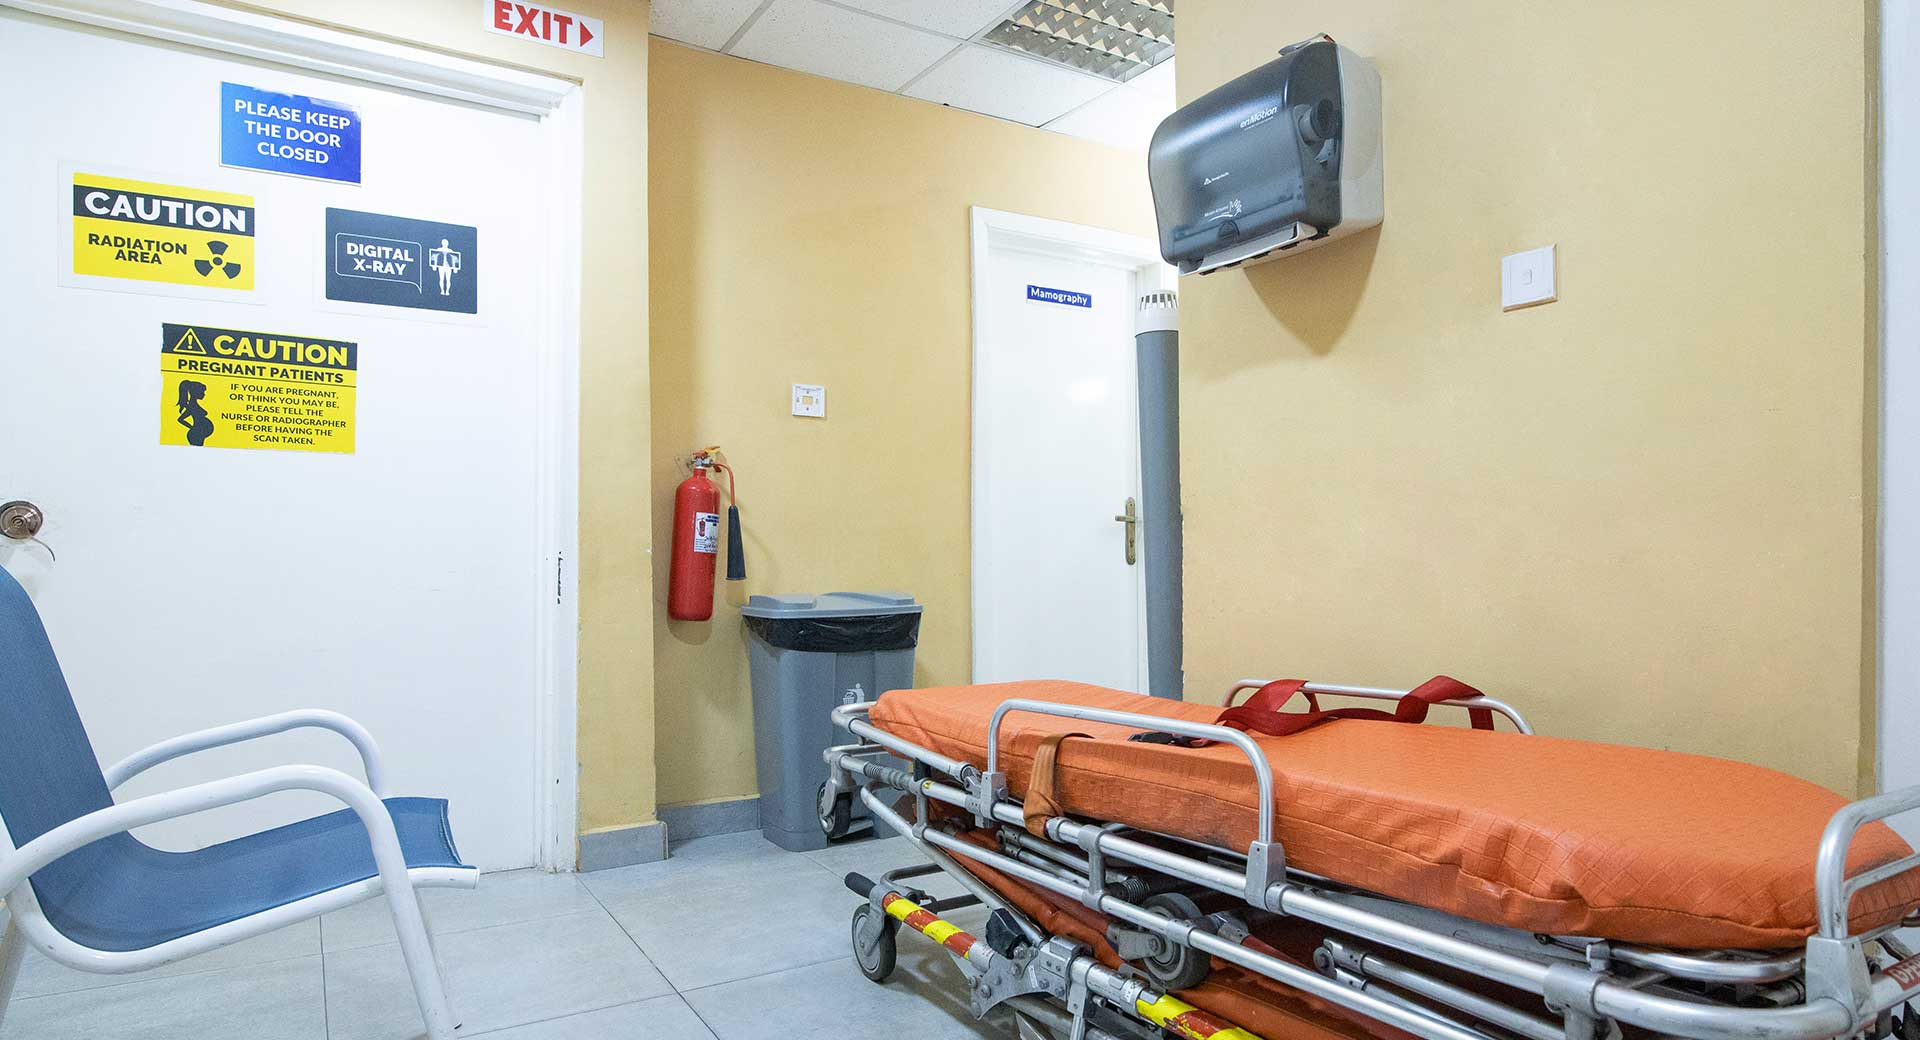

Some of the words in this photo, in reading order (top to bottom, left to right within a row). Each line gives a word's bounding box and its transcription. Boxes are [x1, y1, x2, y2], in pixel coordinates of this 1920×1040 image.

[494, 0, 573, 44] EXIT
[235, 99, 301, 122] PLEASE
[306, 111, 351, 130] KEEP
[244, 120, 281, 138] THE
[286, 127, 342, 148] DOOR
[257, 142, 329, 164] CLOSED
[84, 191, 246, 232] CAUTION
[88, 233, 188, 255] RADIATION
[346, 242, 414, 262] DIGITAL
[115, 249, 162, 265] AREA
[353, 258, 407, 276] X-RAY
[1031, 287, 1088, 306] Mamography
[213, 335, 347, 367] CAUTION
[178, 358, 265, 377] PREGNANT
[270, 367, 344, 384] PATIENTS
[230, 383, 239, 391] IF
[242, 384, 263, 393] YOU
[265, 386, 284, 395] ARE
[229, 393, 244, 401] OR
[246, 394, 277, 404] THINK
[279, 397, 300, 405] YOU
[302, 398, 324, 407] MAY
[221, 412, 254, 422] NURSE
[255, 415, 270, 423] OR
[272, 416, 346, 428] RADIOGRAPHER
[246, 404, 280, 414] PLEASE
[282, 407, 303, 415] TELL
[305, 408, 324, 417] THE
[235, 423, 273, 433] BEFORE
[275, 426, 313, 436] HAVING
[315, 428, 333, 437] THE
[253, 435, 280, 443] SCAN
[282, 436, 315, 446] TAKEN.
